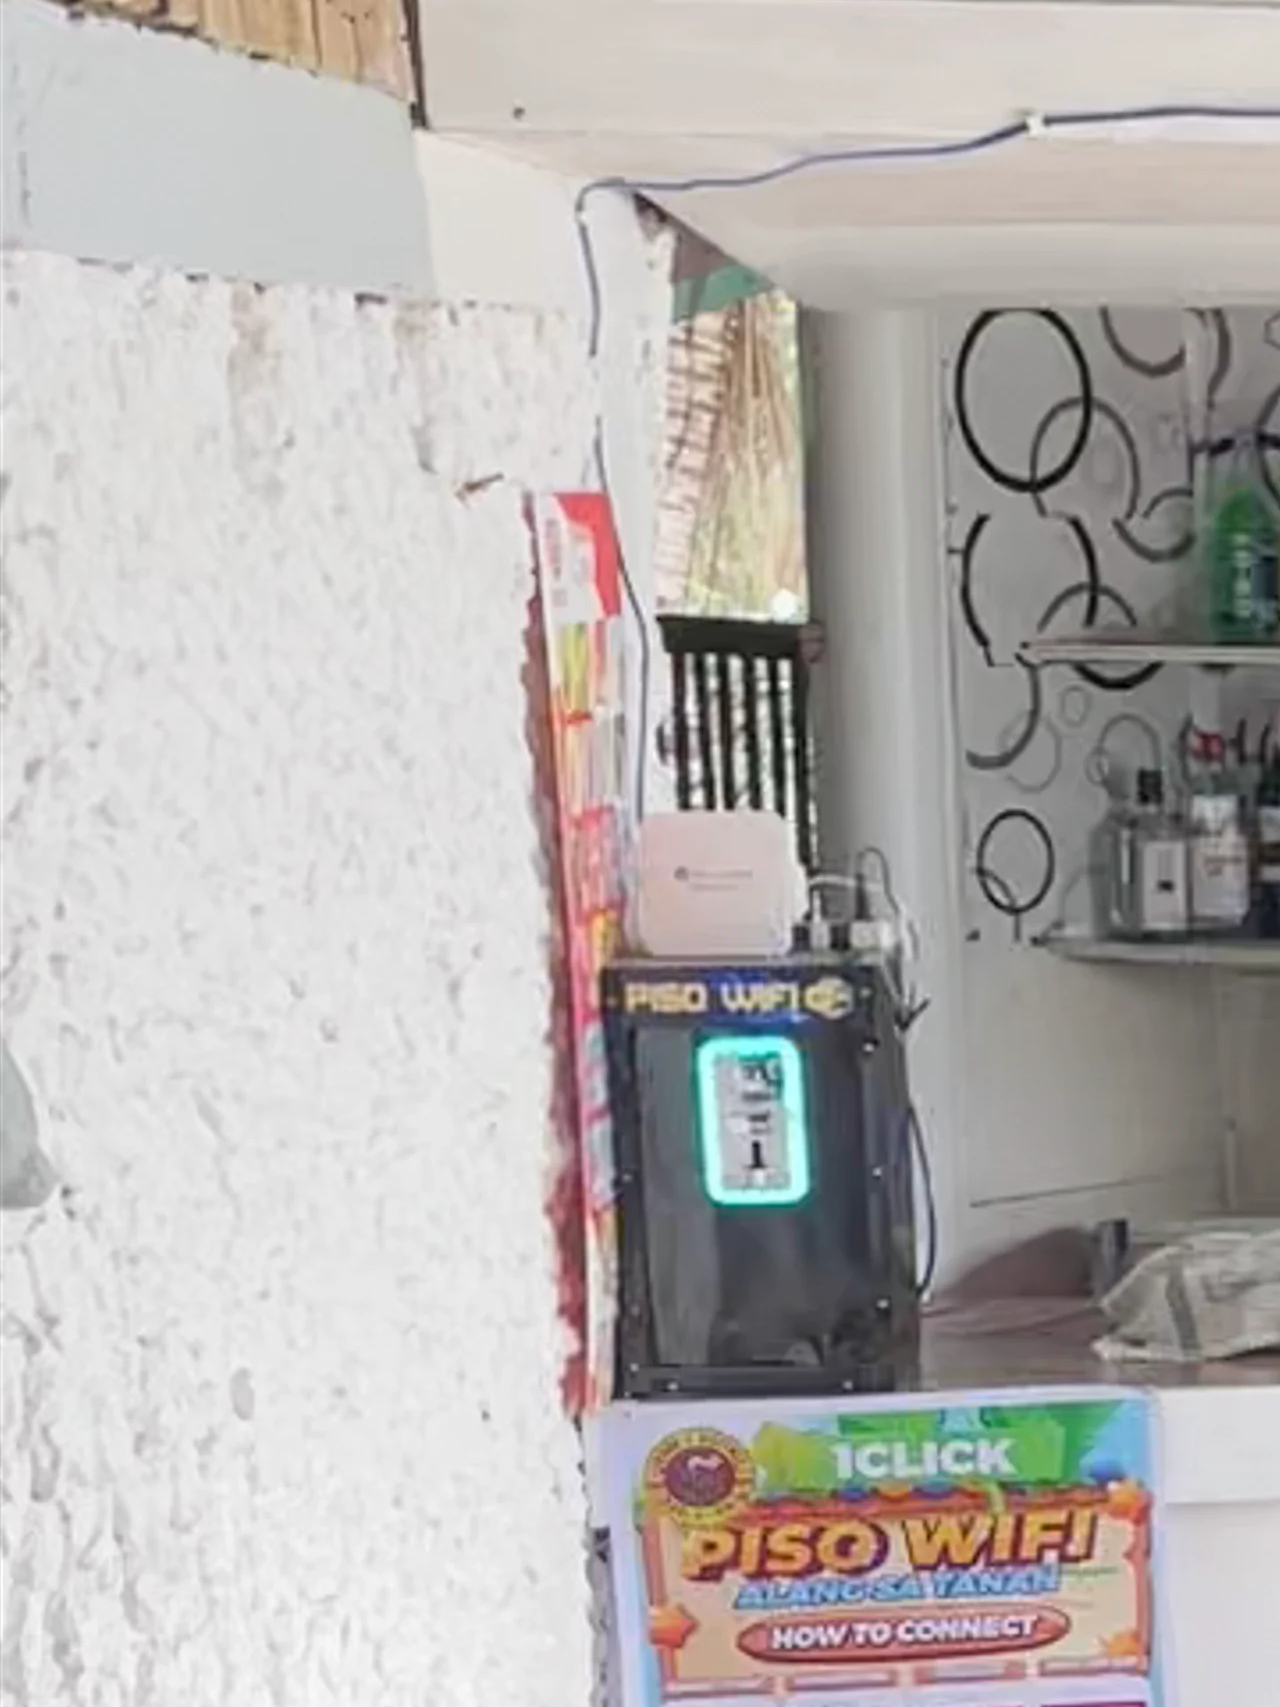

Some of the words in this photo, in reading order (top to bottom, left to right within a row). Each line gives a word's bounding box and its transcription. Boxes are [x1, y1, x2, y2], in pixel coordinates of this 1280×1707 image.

[625, 982, 708, 1013] PISO
[721, 982, 800, 1013] WIFI
[832, 1437, 1016, 1480] 1CLICK
[682, 1519, 890, 1581] PISO
[902, 1508, 1099, 1569] WIFI
[869, 1575, 927, 1603] SA
[772, 1624, 849, 1650] HOW
[853, 1621, 891, 1645] TO
[898, 1615, 1039, 1642] CONNECT
